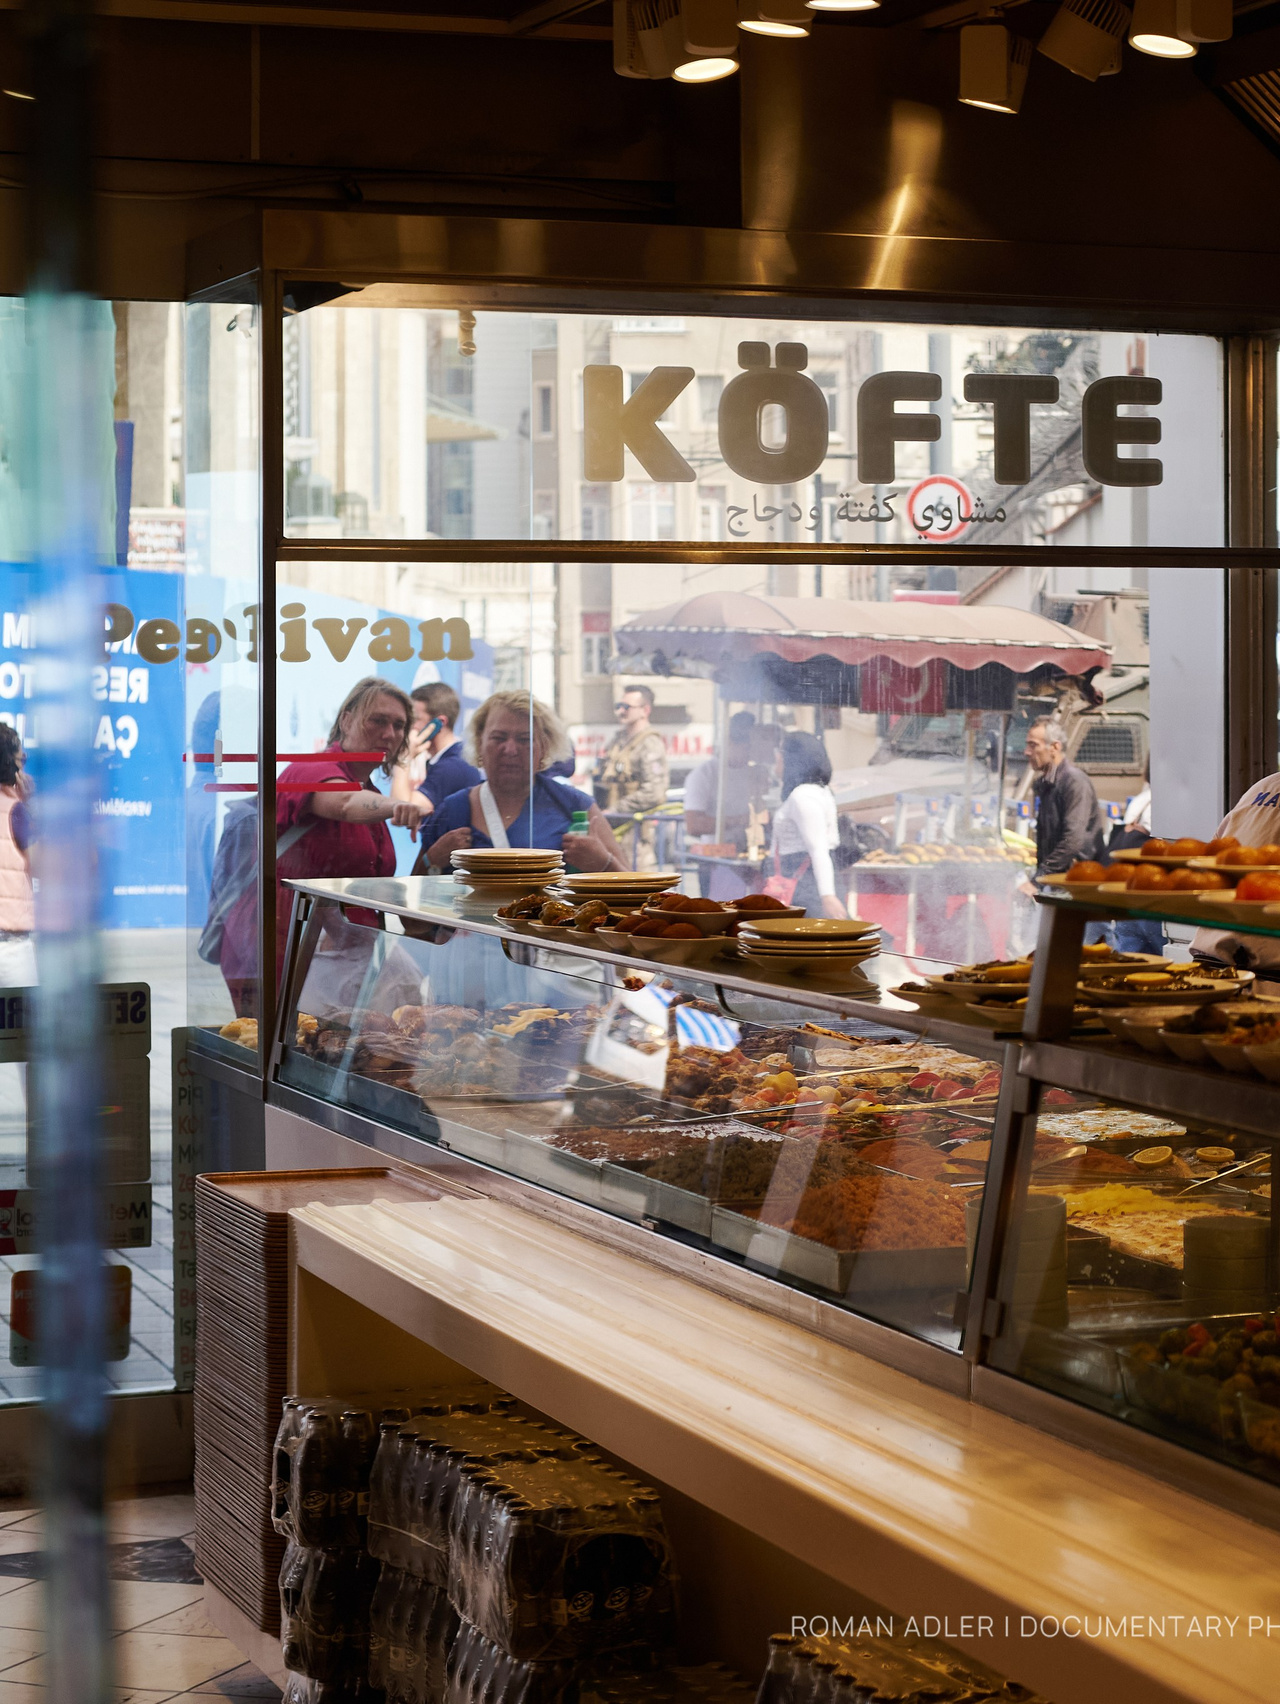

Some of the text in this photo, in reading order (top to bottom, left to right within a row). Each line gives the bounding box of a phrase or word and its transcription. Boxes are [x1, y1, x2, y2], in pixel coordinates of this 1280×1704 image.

[582, 340, 1164, 488] KÖFTE
[835, 492, 899, 523] كفتة
[911, 494, 1007, 540] مشاوي
